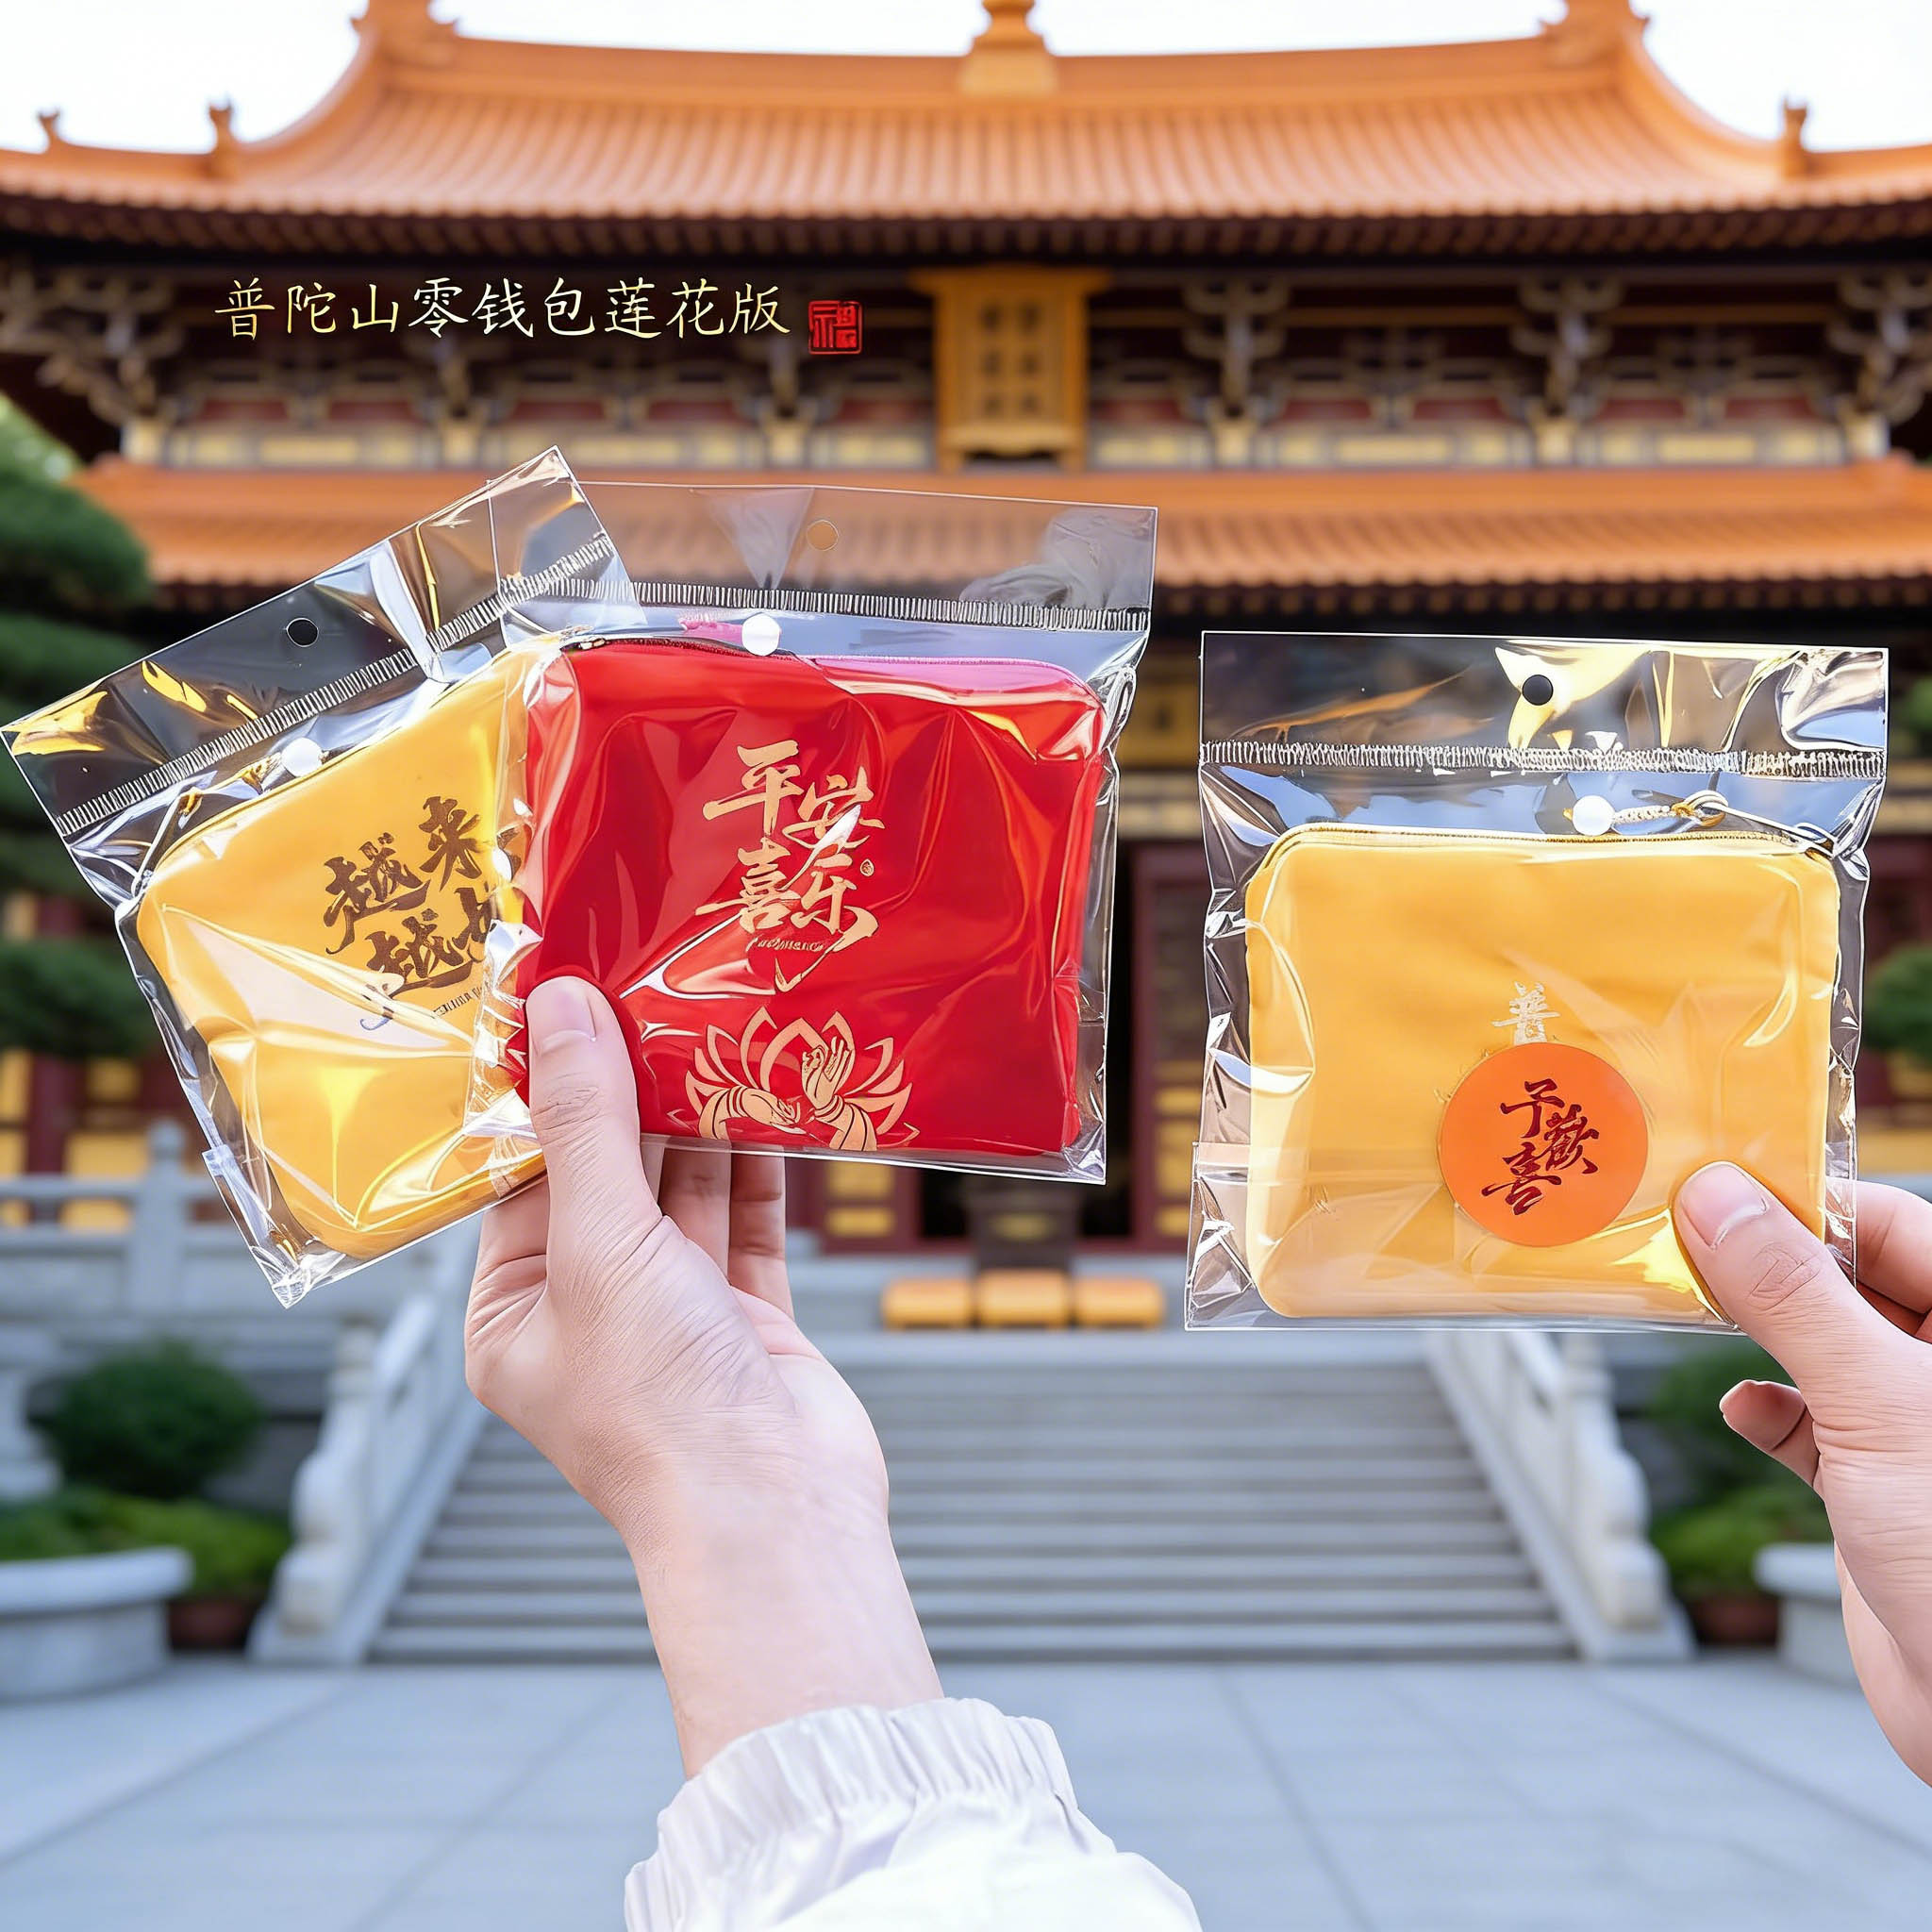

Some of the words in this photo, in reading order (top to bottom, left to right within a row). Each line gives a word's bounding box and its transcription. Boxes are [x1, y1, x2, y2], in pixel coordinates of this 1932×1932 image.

[702, 740, 885, 849] 平安
[323, 795, 485, 955] 越来
[694, 836, 880, 993] 喜乐
